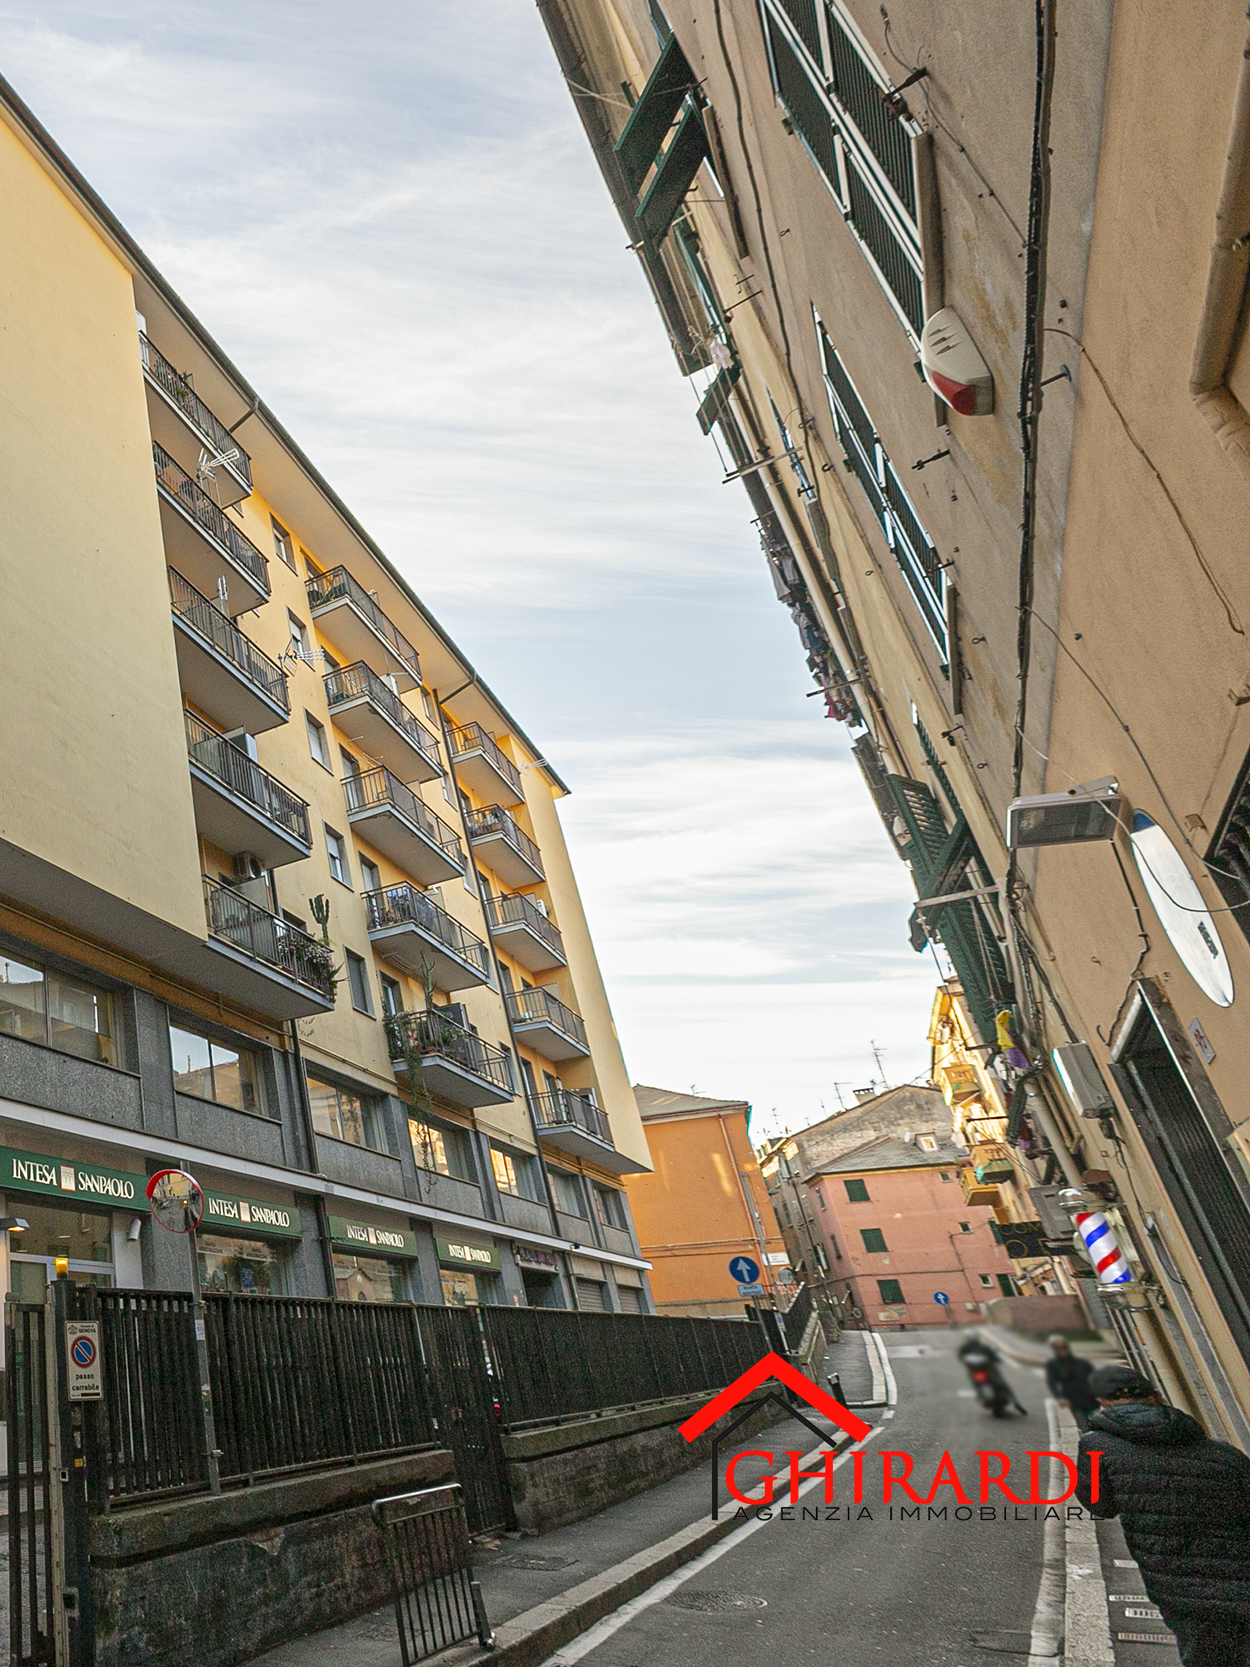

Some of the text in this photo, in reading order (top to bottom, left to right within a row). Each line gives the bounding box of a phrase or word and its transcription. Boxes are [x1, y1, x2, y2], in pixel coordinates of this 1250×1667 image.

[12, 1159, 135, 1199] INTESA SANPAOLO
[208, 1198, 290, 1227] INTESA SANPAOLO
[346, 1224, 405, 1248] INTESA SANPAOLO
[71, 1383, 100, 1392] carrabile
[75, 1373, 95, 1381] passo
